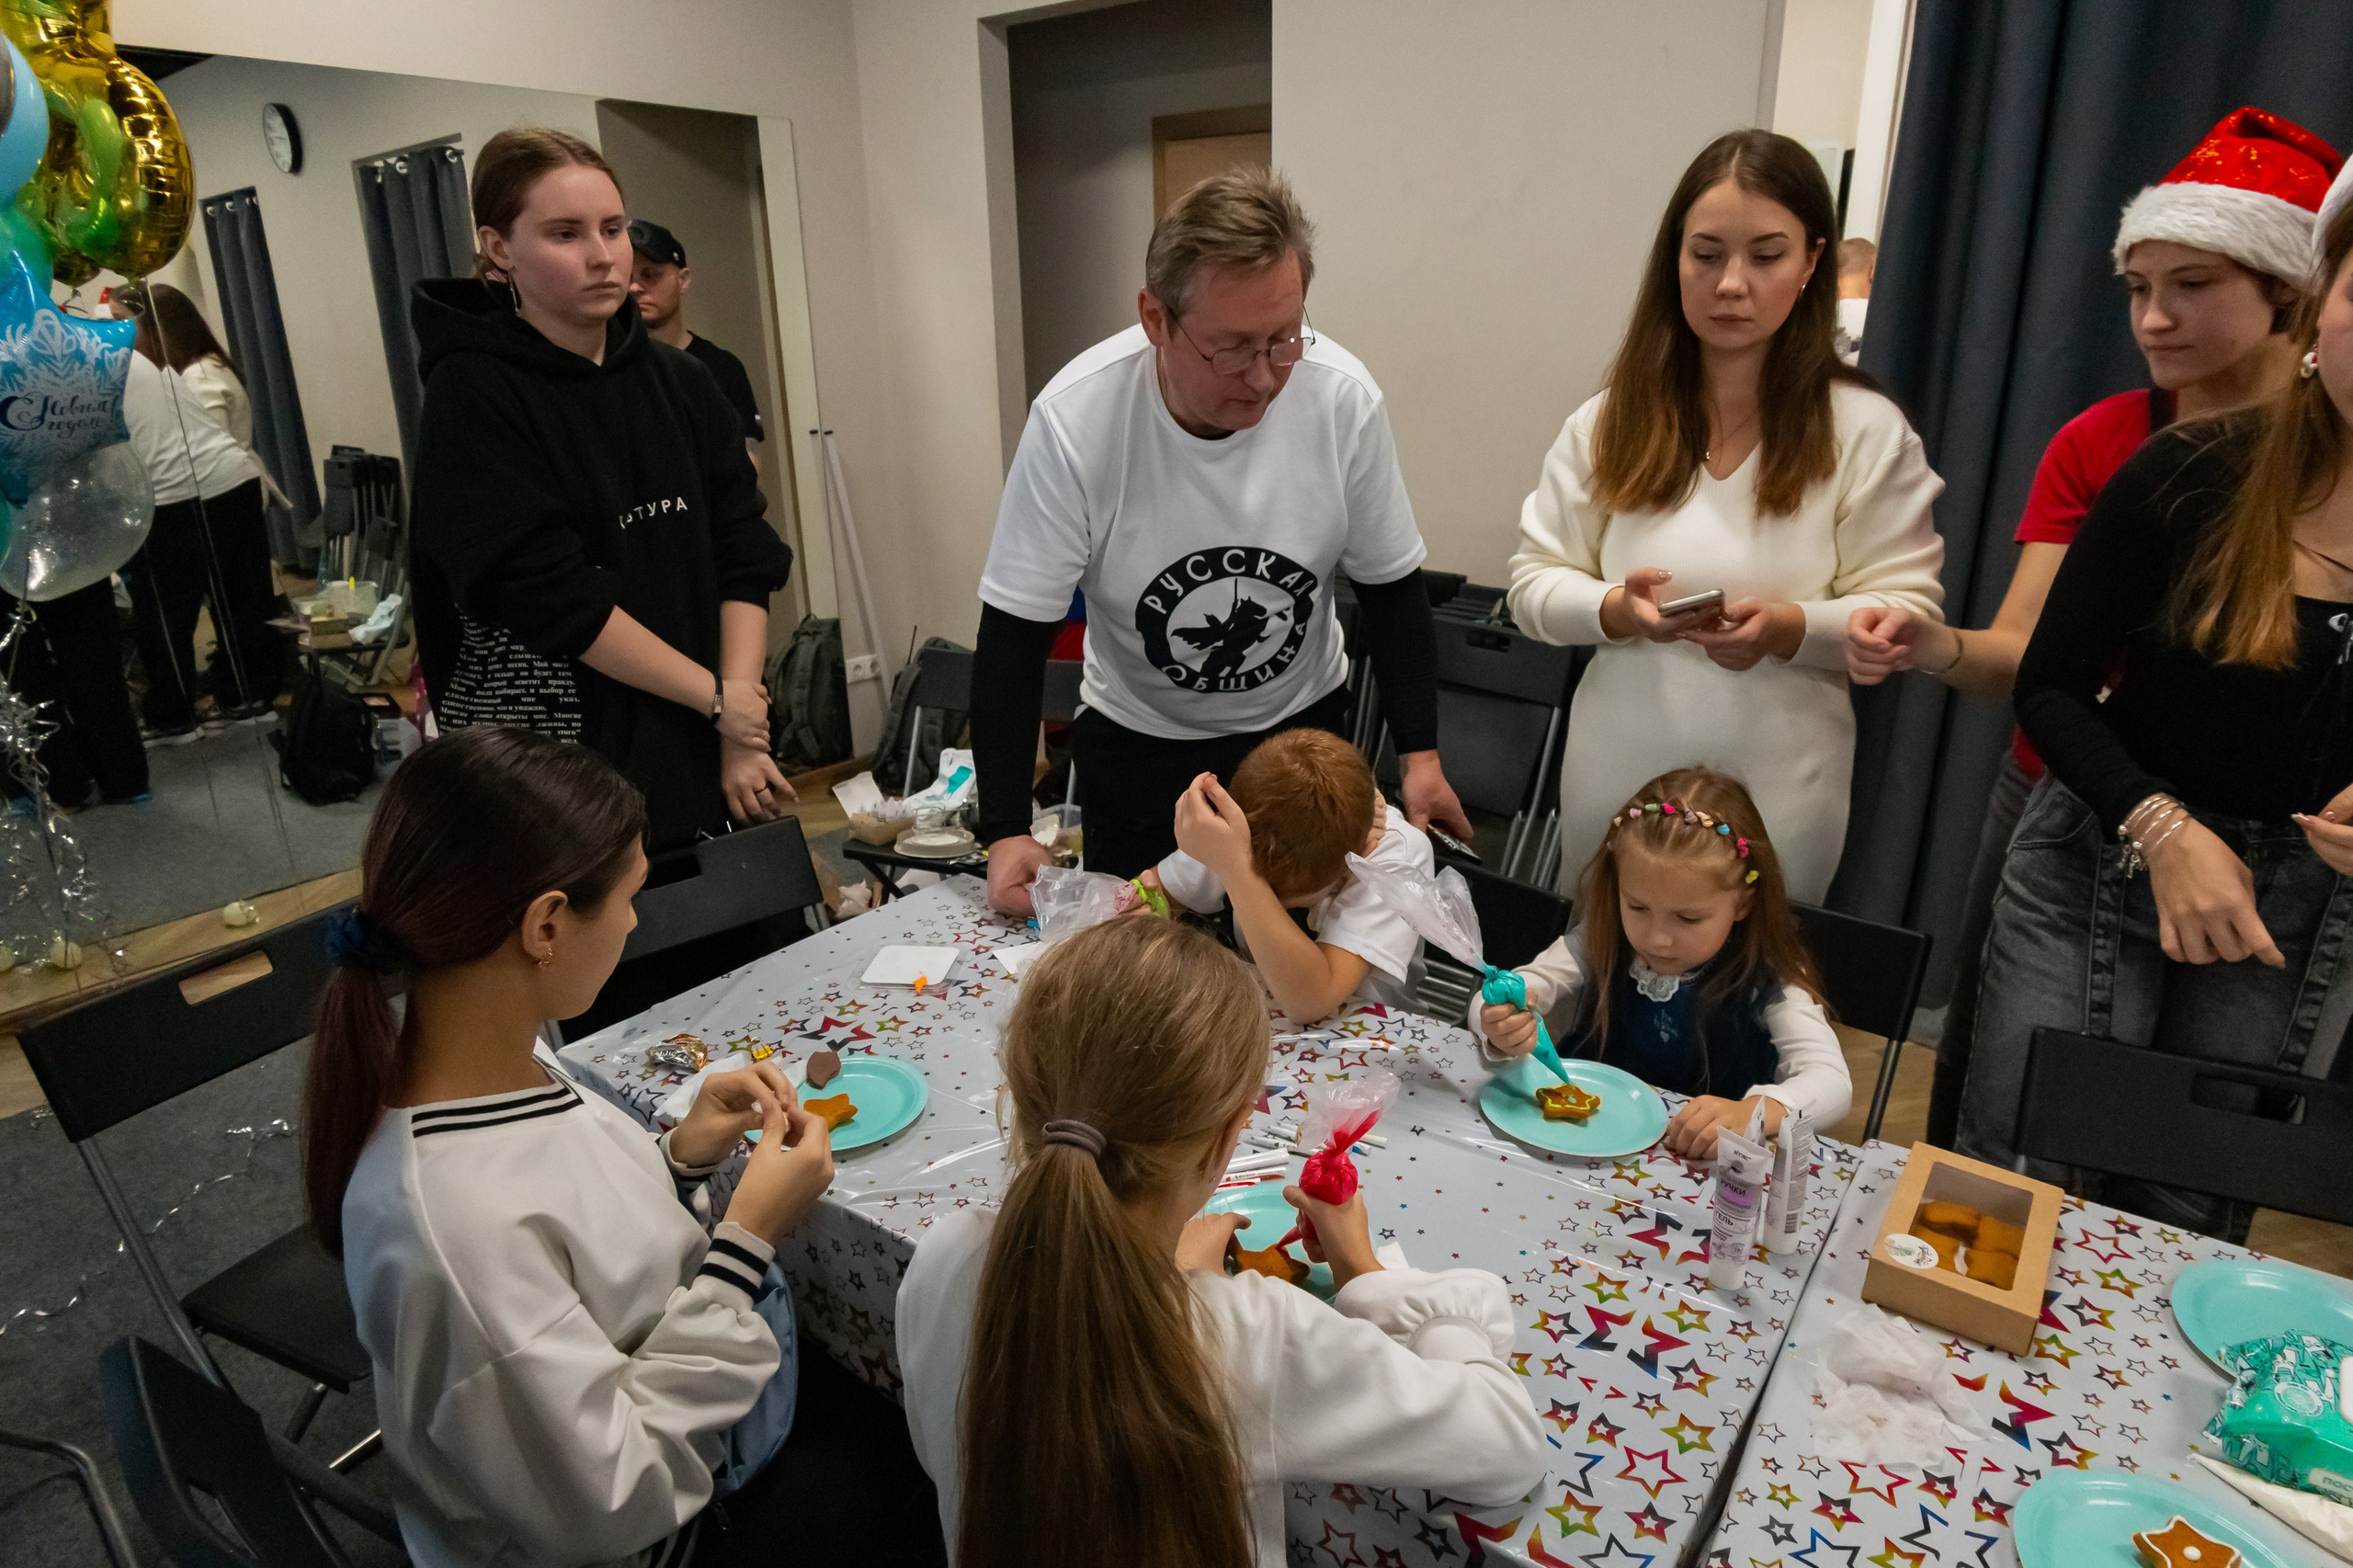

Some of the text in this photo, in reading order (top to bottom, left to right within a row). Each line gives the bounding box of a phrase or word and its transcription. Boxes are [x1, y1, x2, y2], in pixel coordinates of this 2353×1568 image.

[1143, 549, 1314, 615] РУССКАЯ
[1162, 622, 1306, 690] ОБЩИНА
[1720, 1177, 1747, 1197] РУЧКИ
[1715, 1210, 1733, 1226] ГЕЛЬ
